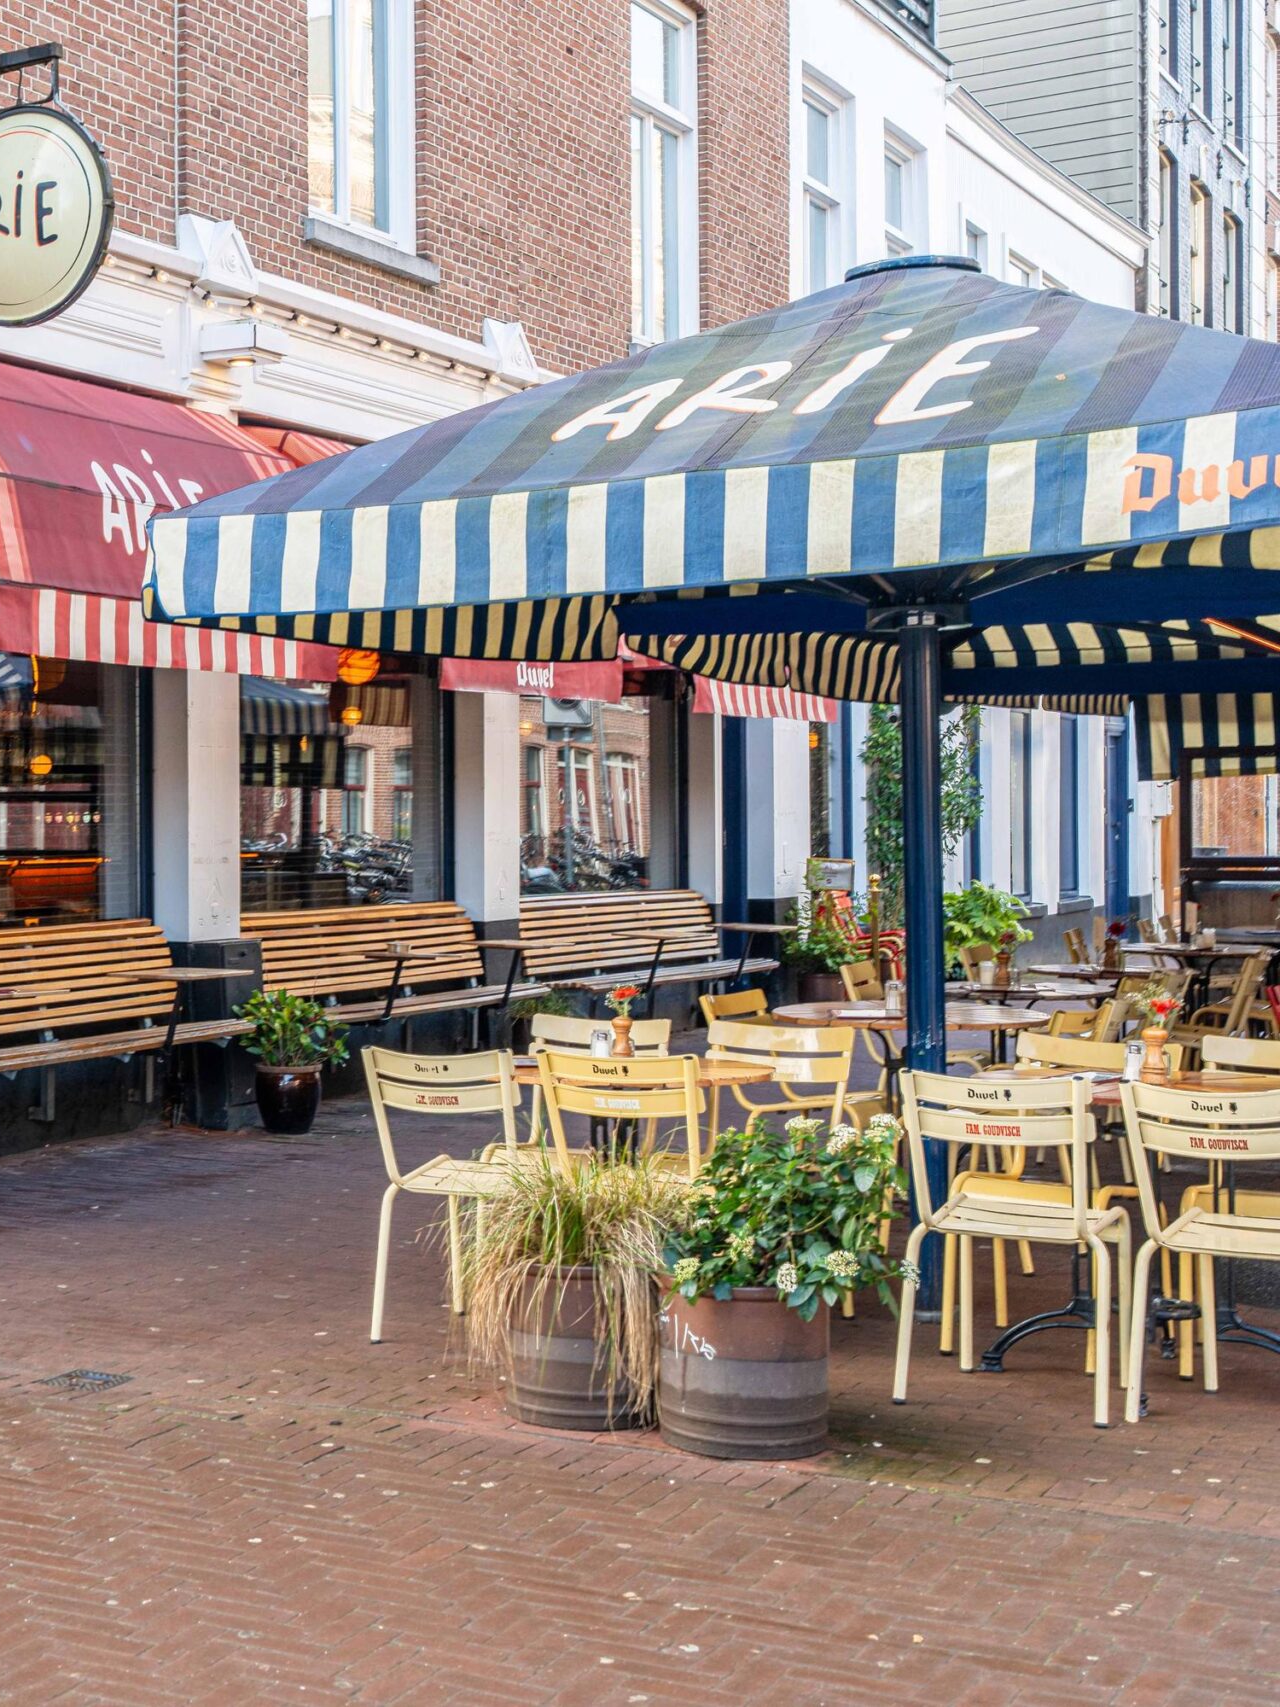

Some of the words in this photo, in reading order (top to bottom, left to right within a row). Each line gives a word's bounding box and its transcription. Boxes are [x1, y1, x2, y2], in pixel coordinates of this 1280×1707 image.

[1121, 452, 1280, 516] Duv
[516, 660, 554, 689] Duvel
[414, 1063, 439, 1074] Duel
[592, 1064, 619, 1075] Duvel
[967, 1088, 999, 1100] Duvel
[1191, 1100, 1223, 1113] Duvel
[965, 1123, 982, 1135] FAM.
[982, 1124, 1022, 1137] GOUDVISCH
[1189, 1136, 1208, 1150] FAM.
[1208, 1137, 1249, 1152] GOUDVISCH
